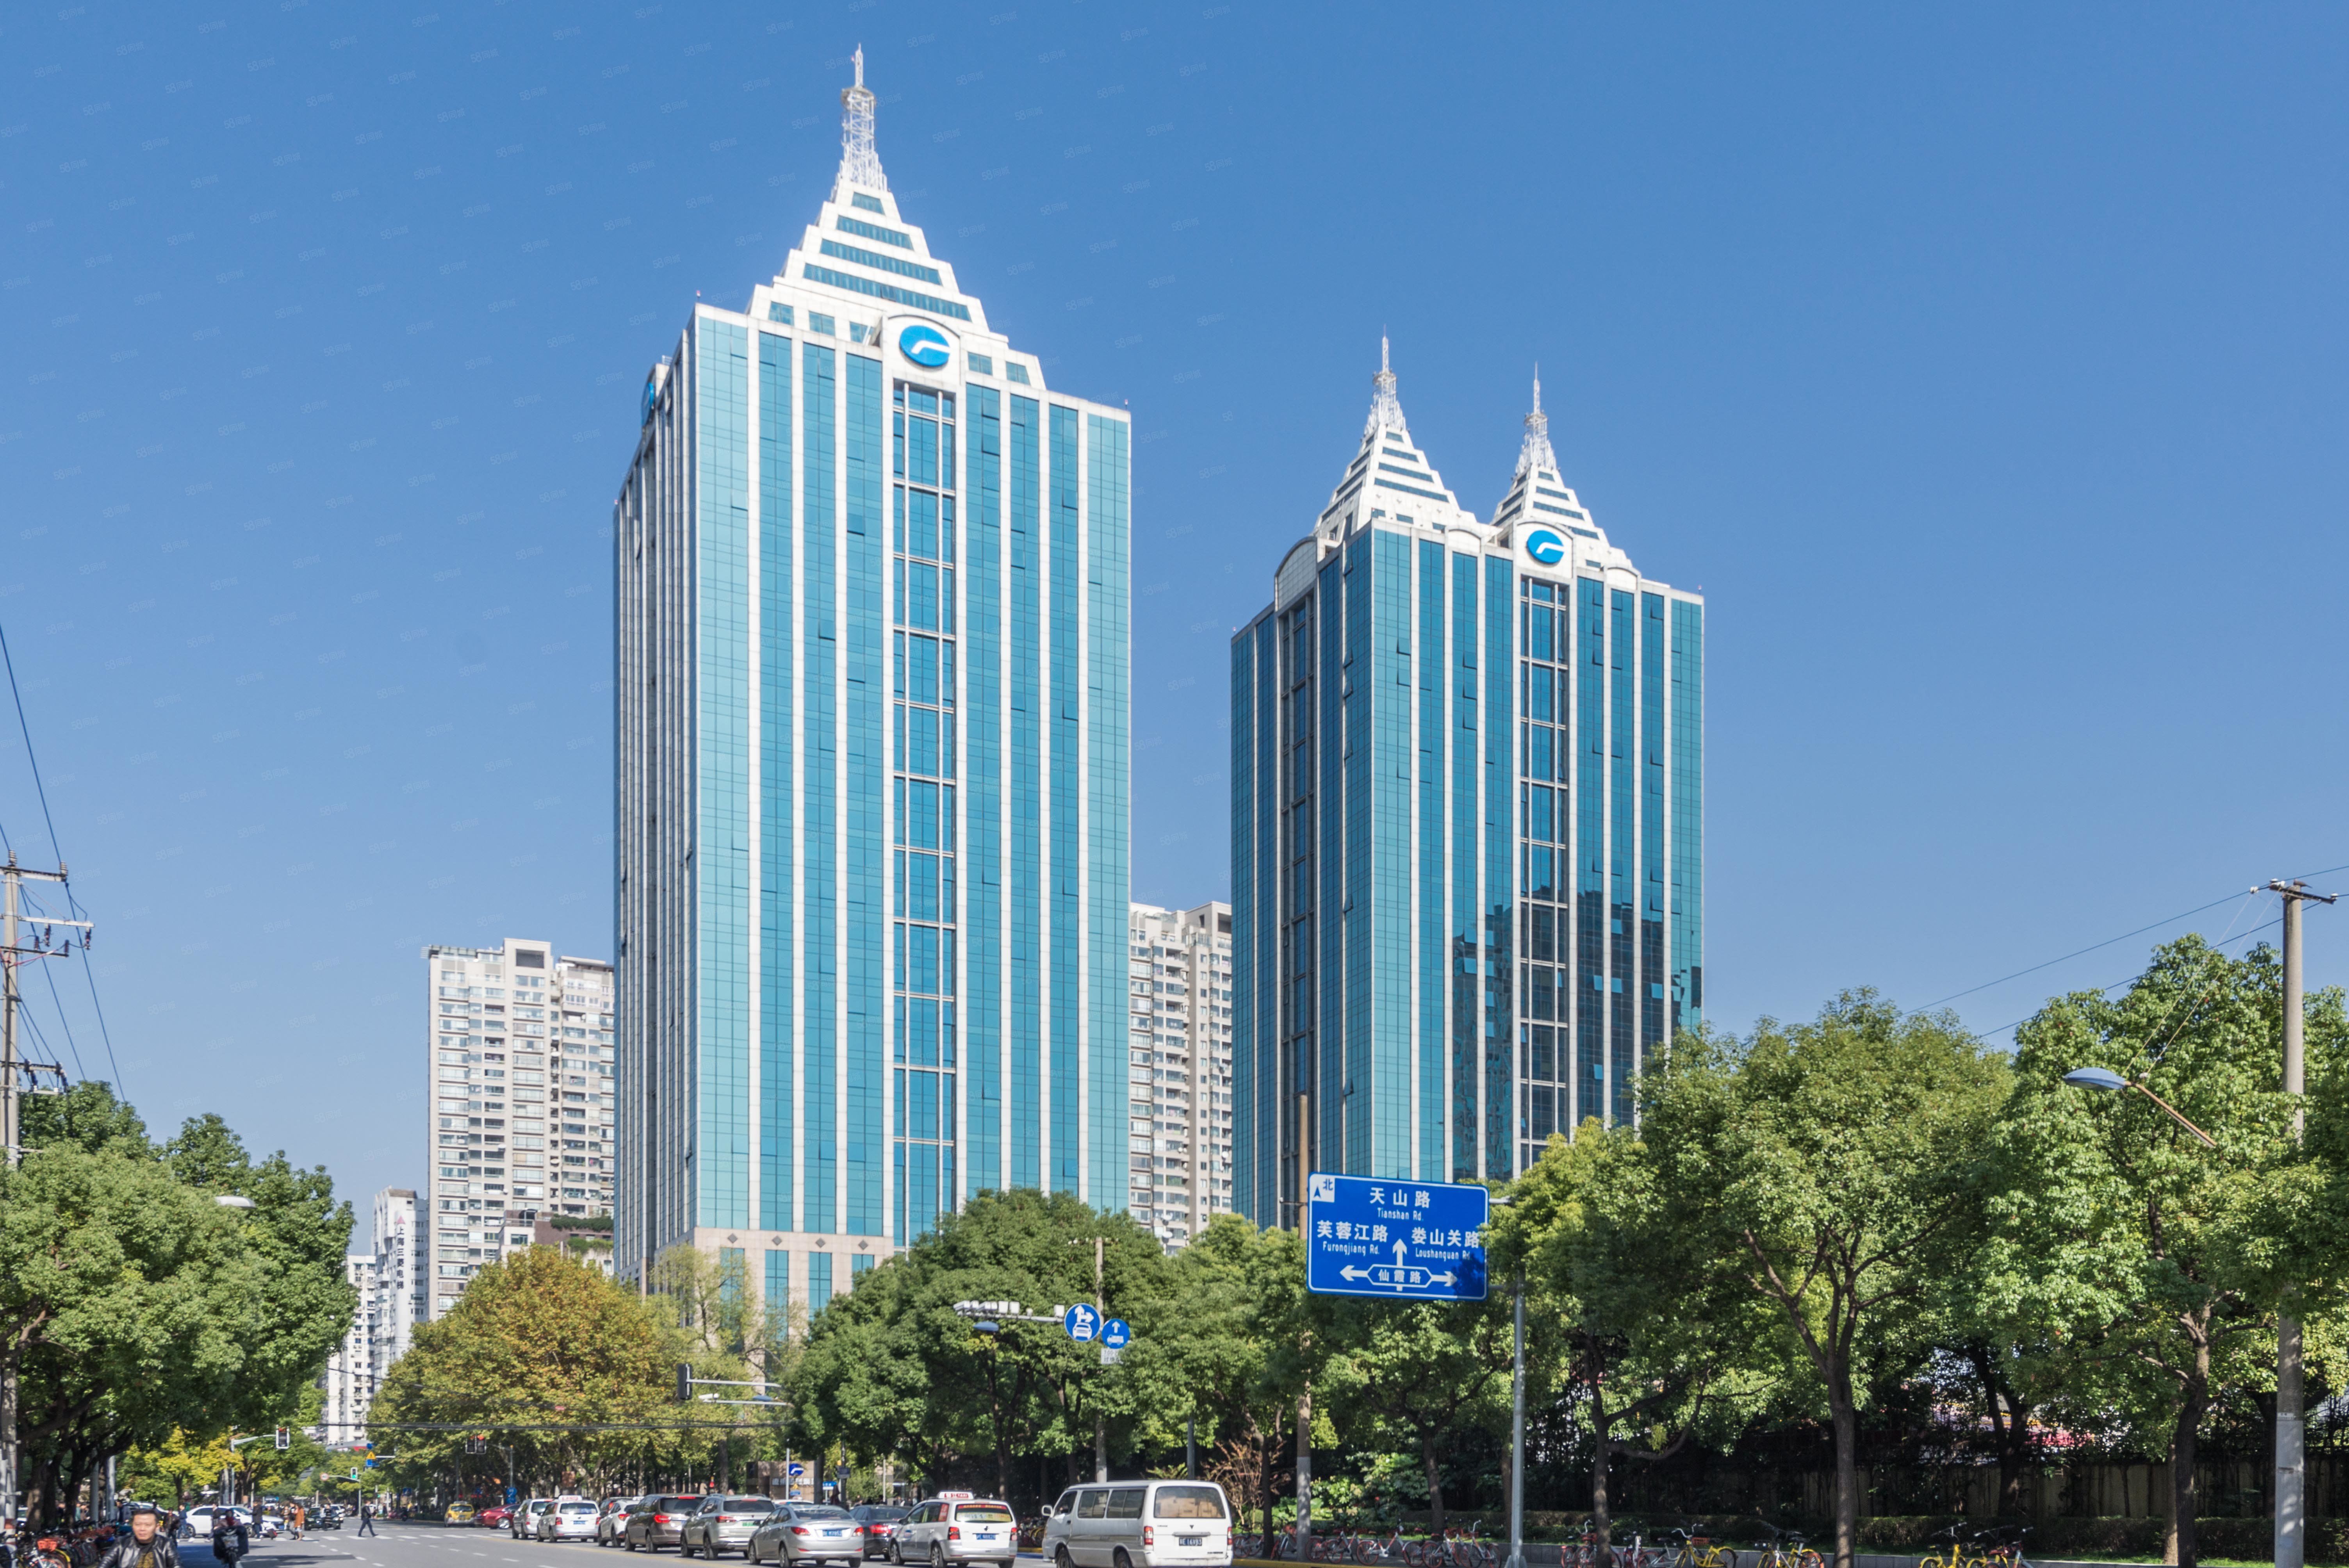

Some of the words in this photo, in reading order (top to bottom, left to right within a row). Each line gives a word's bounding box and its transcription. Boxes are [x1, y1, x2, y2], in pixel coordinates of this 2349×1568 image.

[1322, 1178, 1333, 1190] 北
[1370, 1187, 1430, 1208] 天山路
[1378, 1207, 1409, 1220] Tianshan
[1317, 1220, 1388, 1242] 芙蓉江路
[1412, 1227, 1480, 1249] 娄山关路
[1323, 1241, 1366, 1256] Furongjiang
[1415, 1247, 1459, 1262] Loushanguan
[1378, 1269, 1421, 1284] 仙霞路
